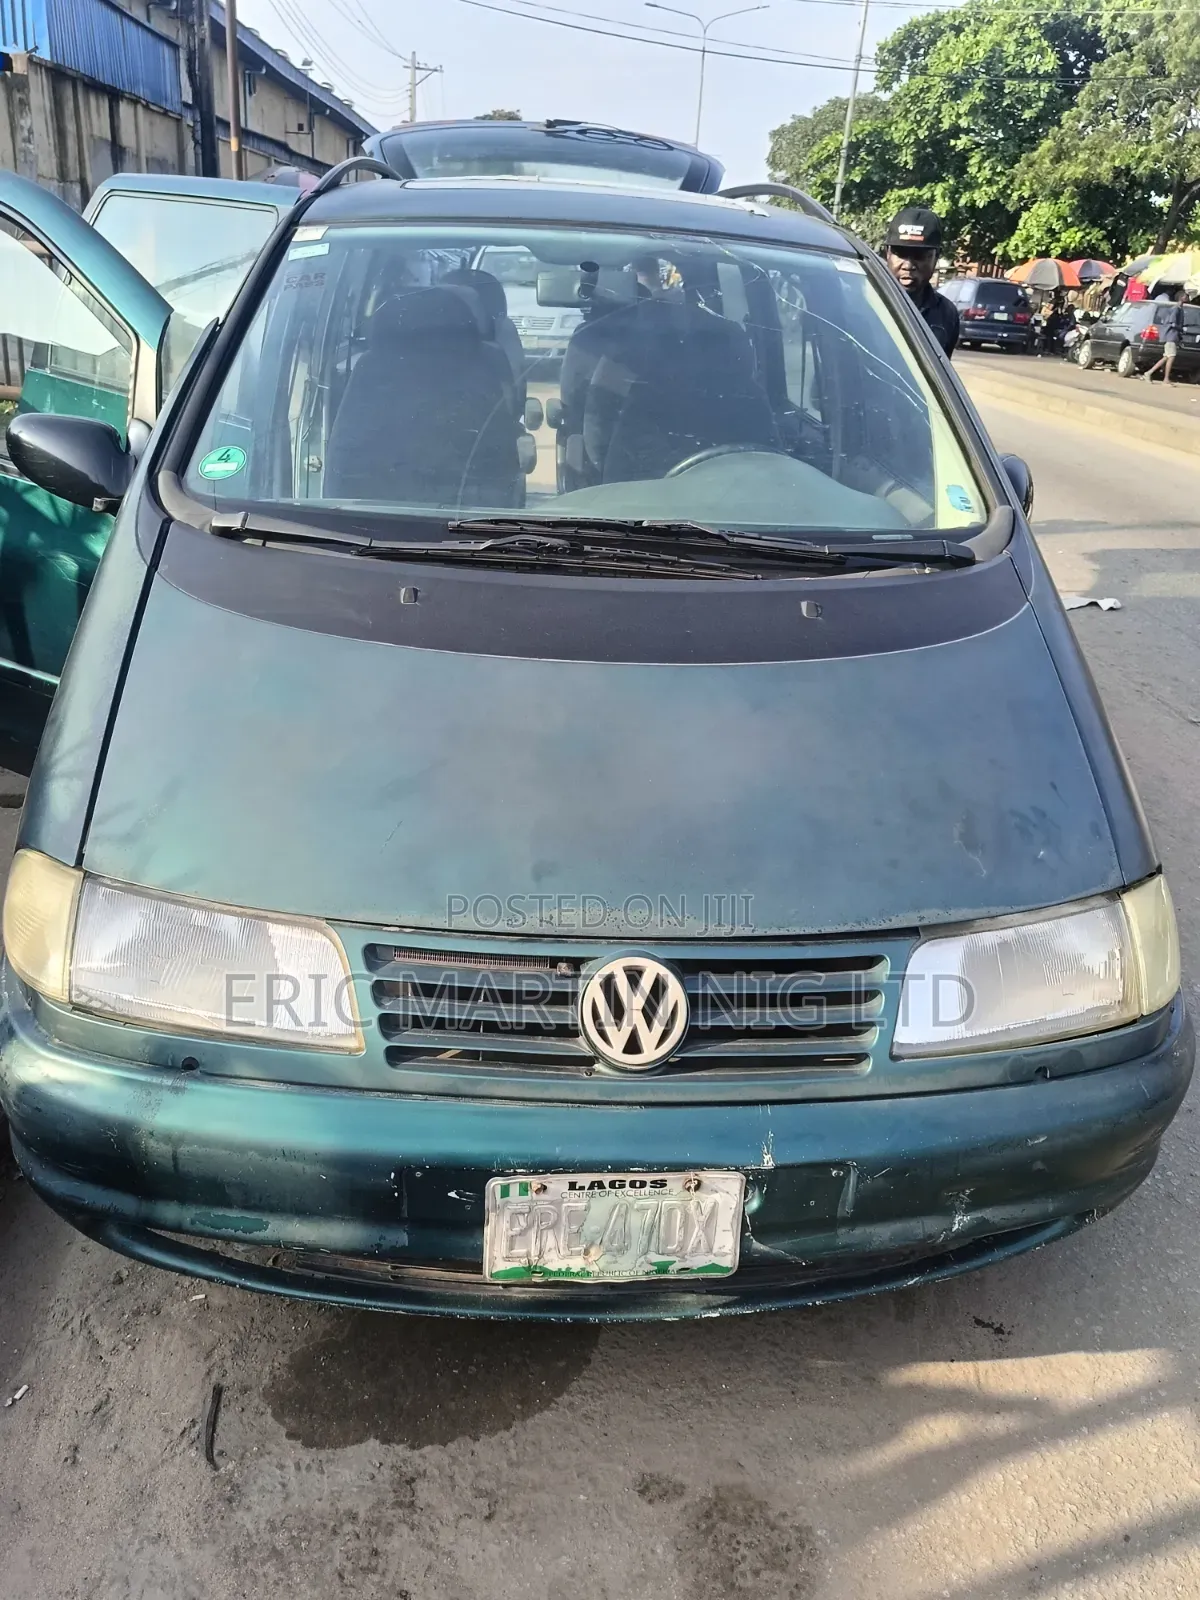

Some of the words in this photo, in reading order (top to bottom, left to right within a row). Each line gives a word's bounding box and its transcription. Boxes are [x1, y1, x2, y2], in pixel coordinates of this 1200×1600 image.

[217, 448, 231, 463] 4
[567, 1179, 667, 1191] LAGOS
[560, 1190, 597, 1200] CENTRE
[598, 1190, 613, 1198] OF
[614, 1188, 674, 1198] EXCELLENCE
